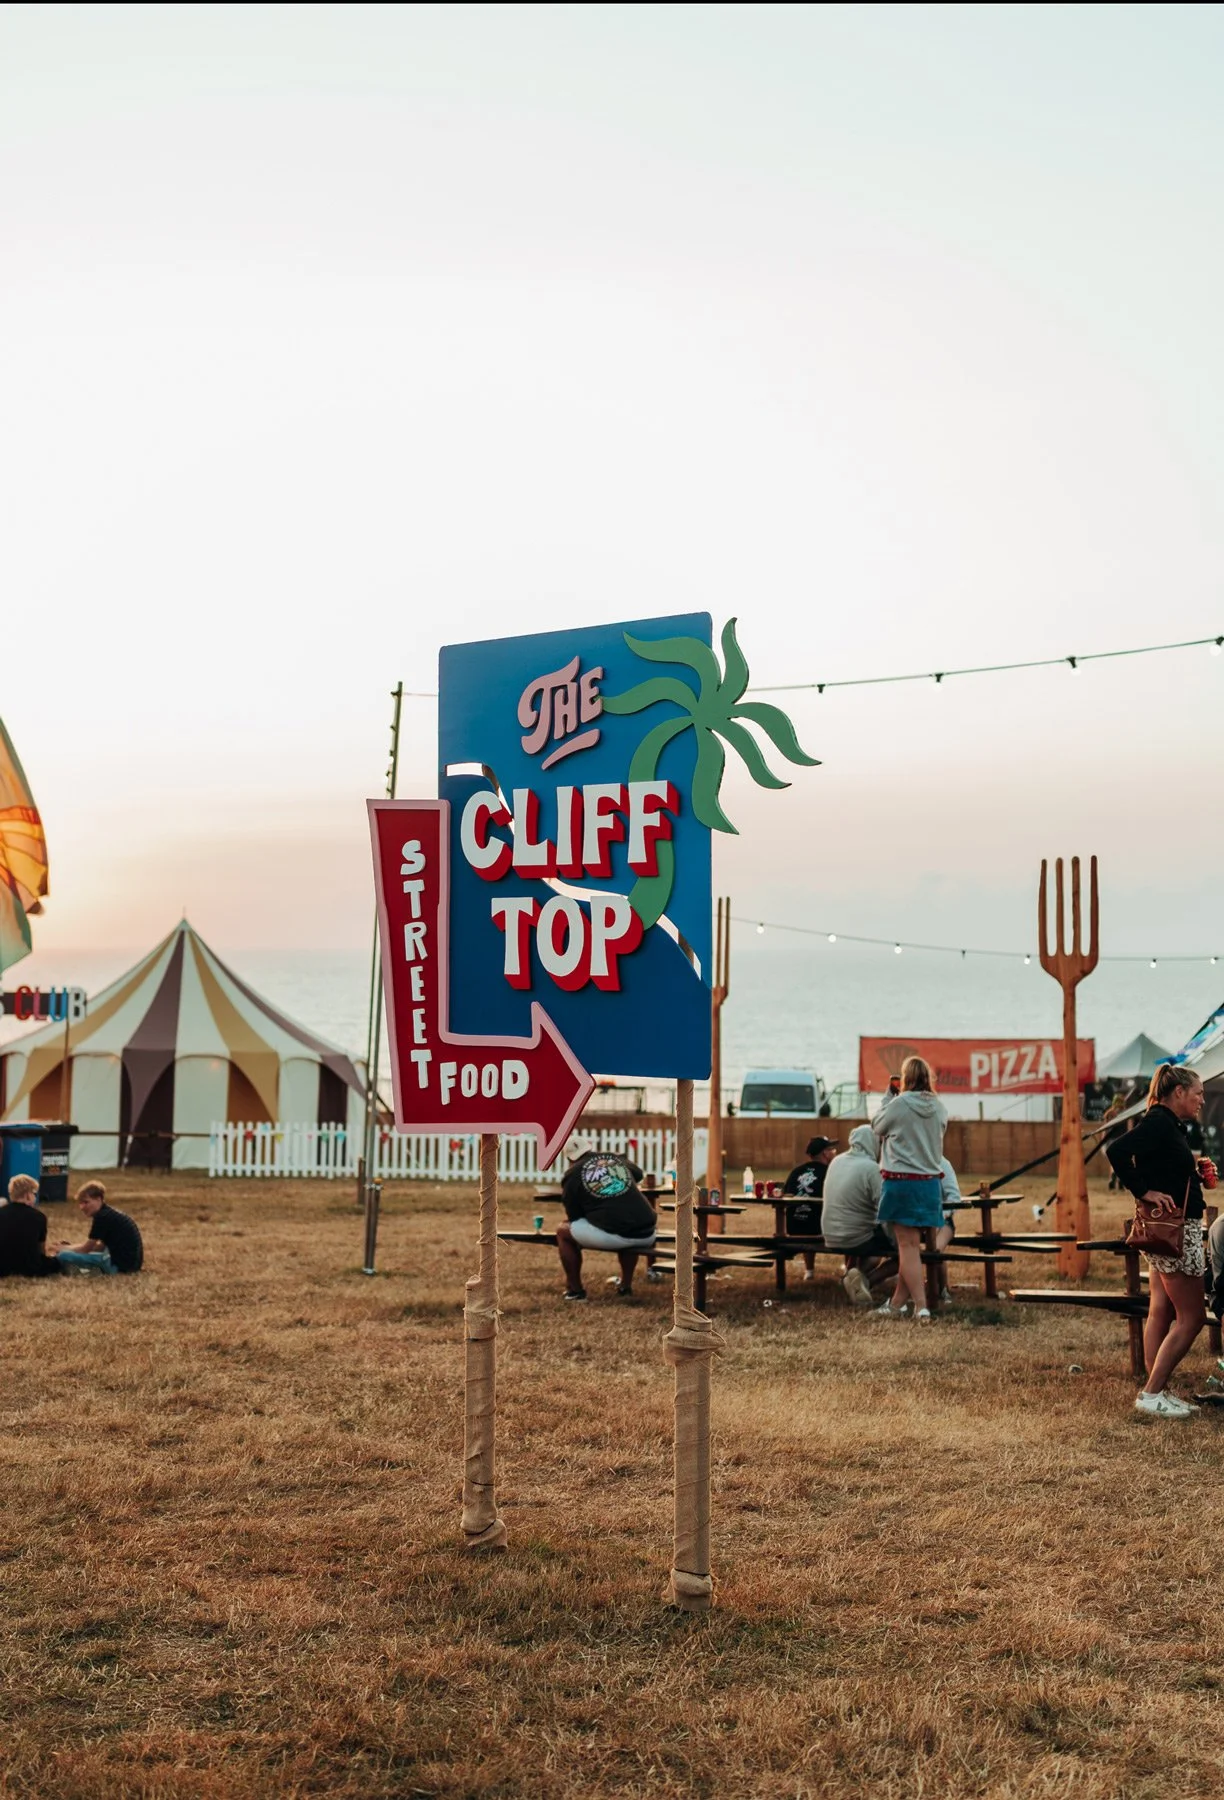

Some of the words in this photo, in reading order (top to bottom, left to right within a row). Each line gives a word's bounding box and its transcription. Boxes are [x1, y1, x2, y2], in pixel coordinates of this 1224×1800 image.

[517, 655, 604, 756] THE
[460, 780, 680, 881] CLIFF
[400, 839, 433, 1089] STREET
[491, 895, 644, 991] TOP
[15, 985, 87, 1024] CLUB
[440, 1058, 530, 1105] FOOD
[970, 1043, 1058, 1088] PIZZA
